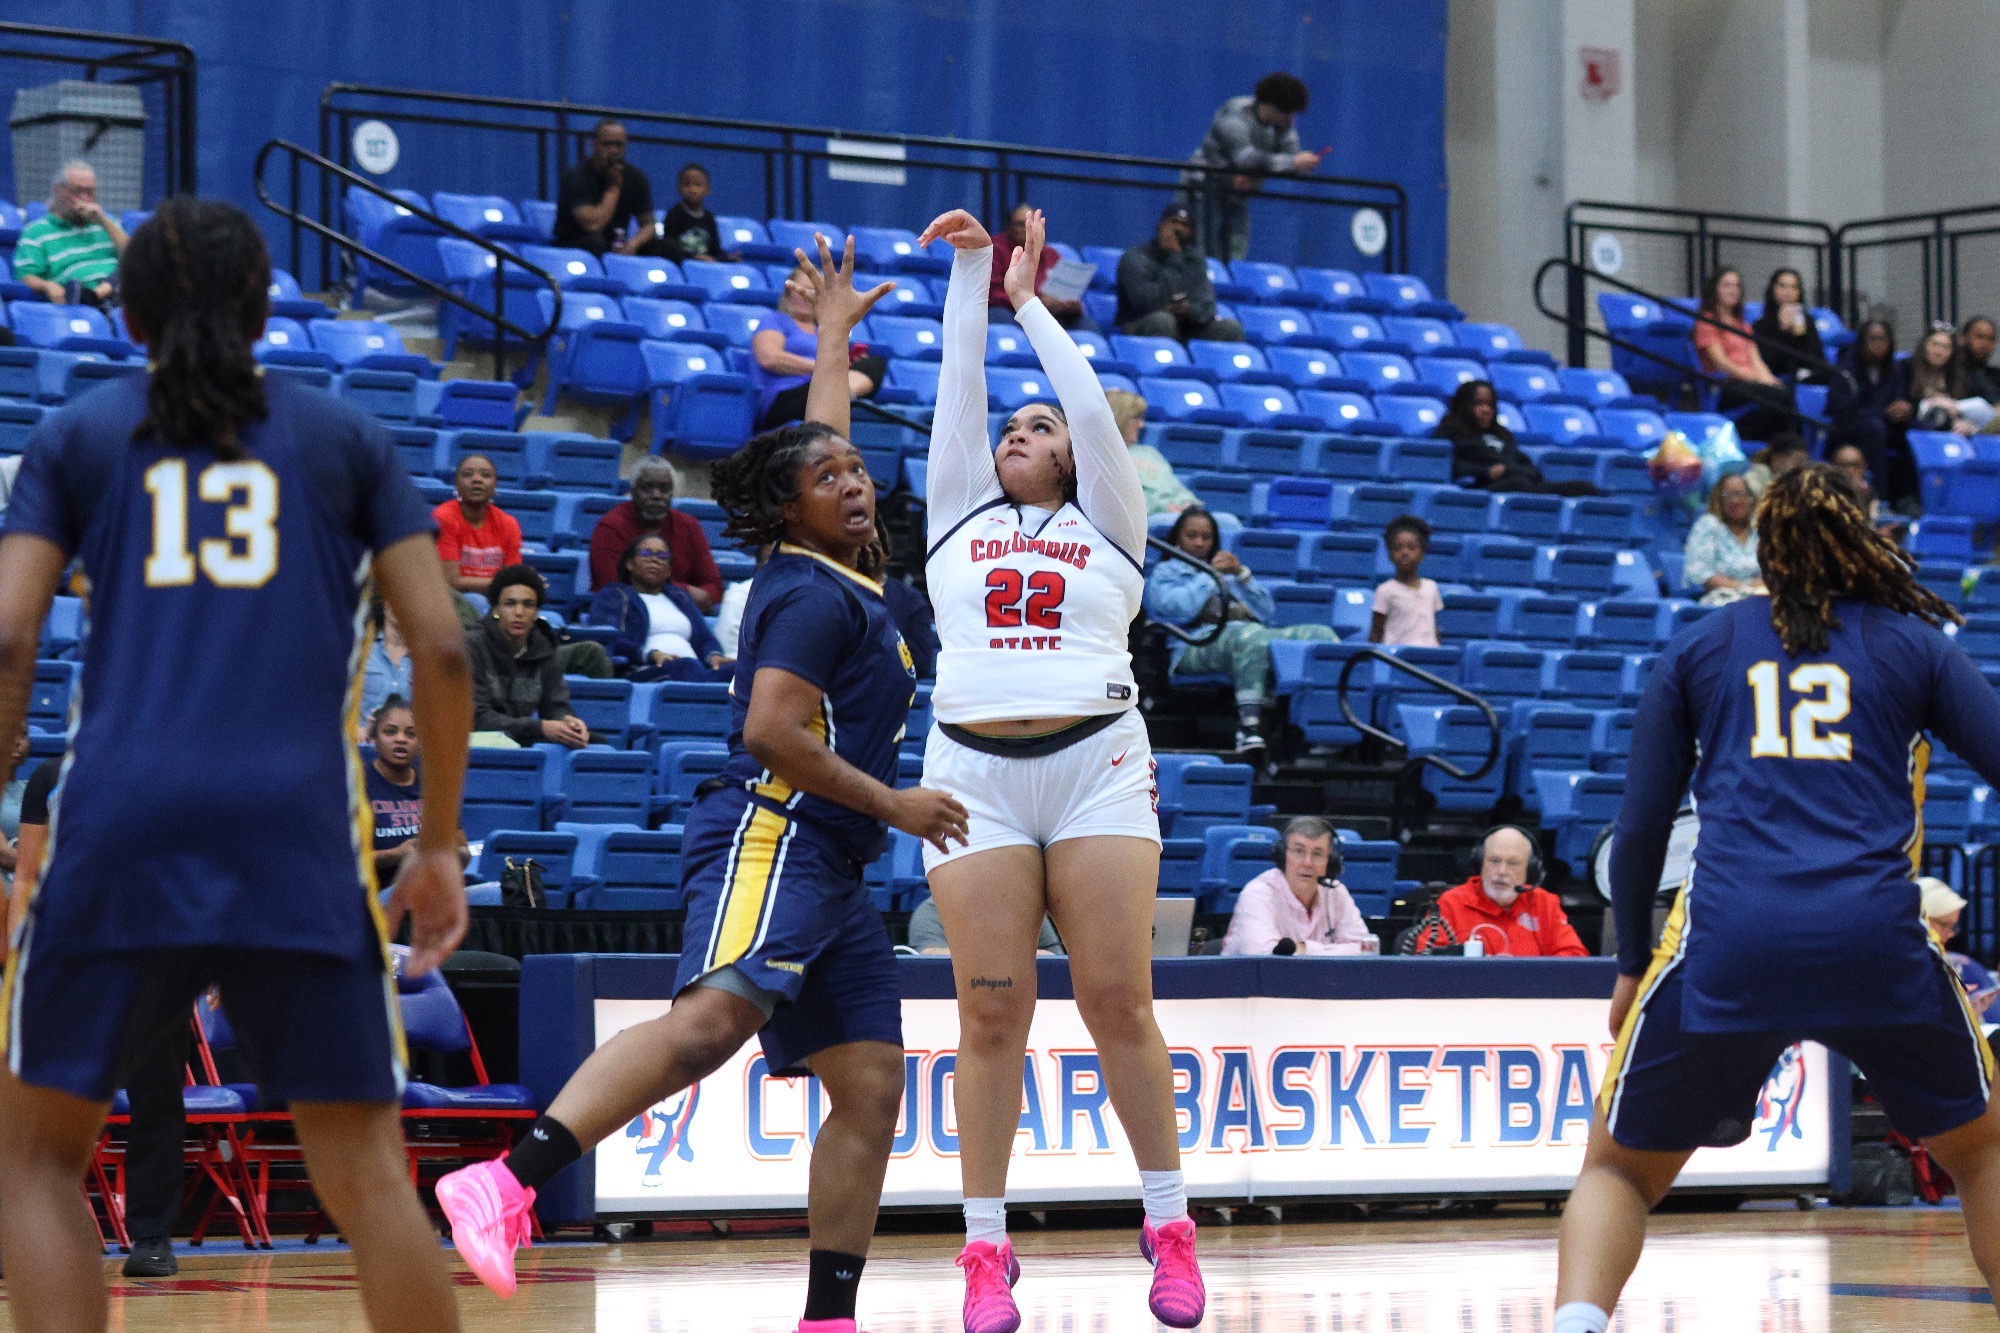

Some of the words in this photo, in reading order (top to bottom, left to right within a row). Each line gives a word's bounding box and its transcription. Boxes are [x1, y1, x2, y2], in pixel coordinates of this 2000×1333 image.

[143, 456, 281, 589] 13
[984, 567, 1066, 630] 22
[1746, 659, 1853, 762] 12
